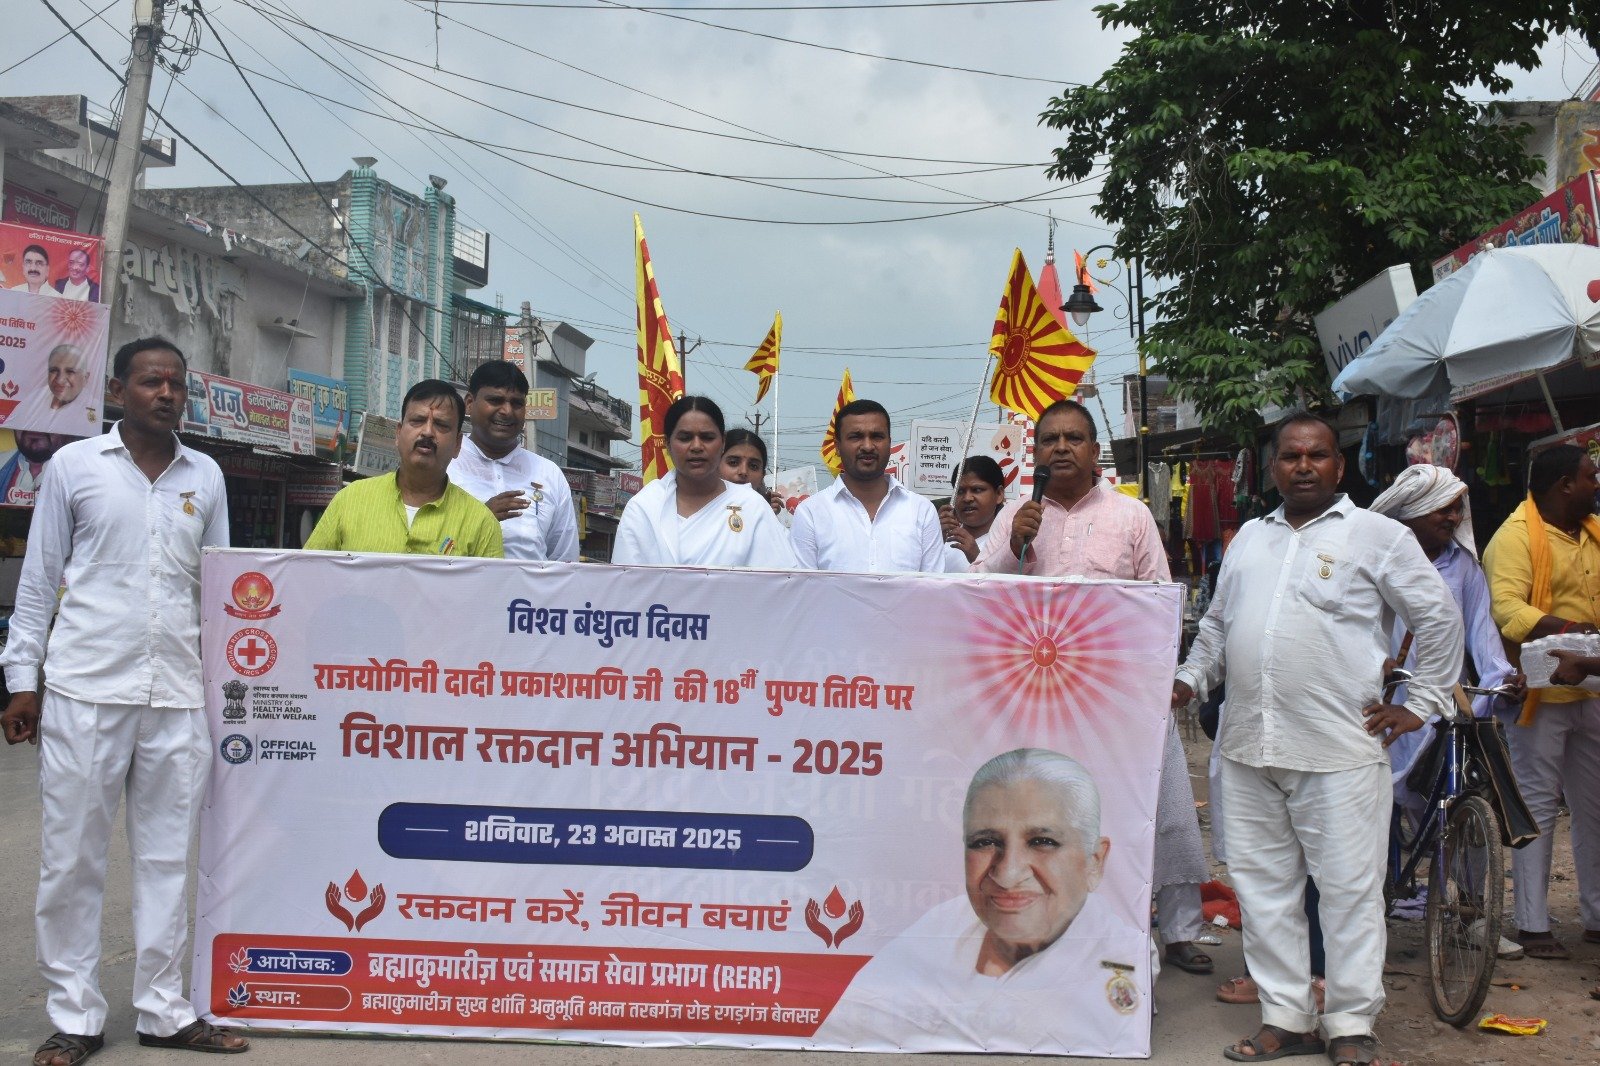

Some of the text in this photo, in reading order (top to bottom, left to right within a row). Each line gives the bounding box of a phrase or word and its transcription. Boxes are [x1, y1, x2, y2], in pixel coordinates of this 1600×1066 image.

[9, 318, 26, 329] तिथि
[27, 322, 36, 330] पर
[0, 336, 26, 348] 2025
[1329, 330, 1373, 373] vivo
[210, 384, 247, 424] राजू
[526, 390, 554, 407] जाद
[508, 598, 710, 648] विश्व बंधुत्व दिवस
[228, 645, 237, 668] INDIAN
[245, 629, 268, 640] CROSS
[267, 640, 277, 668] SOCIETY
[314, 658, 439, 693] राजयोगिनी
[444, 662, 495, 697] दादी
[500, 666, 628, 700] प्रकाशमणि
[633, 667, 663, 702] जी
[674, 669, 708, 704] की
[765, 680, 818, 717] पुण्य
[823, 675, 880, 709] तिथि
[884, 685, 915, 711] पर
[261, 740, 316, 750] OFFICIAL
[261, 751, 316, 761] ATTEMPT
[340, 712, 883, 777] विशाल रक्तदान अभियान - 2025
[465, 816, 742, 850] शनिवार, 23 अगस्त 2025
[396, 888, 791, 931] रक्तदान करें, जीवन बचाएं
[257, 952, 336, 972] आयोजक:
[503, 952, 534, 981] एवं
[539, 958, 600, 984] समाज
[605, 954, 646, 986] सेवा
[651, 962, 708, 988] प्रभाग
[713, 963, 781, 994] (RERF)
[255, 990, 301, 1006] स्थान:
[361, 991, 820, 1025] ब्रह्माकुमारीज सुख शांति अनुभूति भवन तरबगंज रोड रगड़गंज बेलसर
